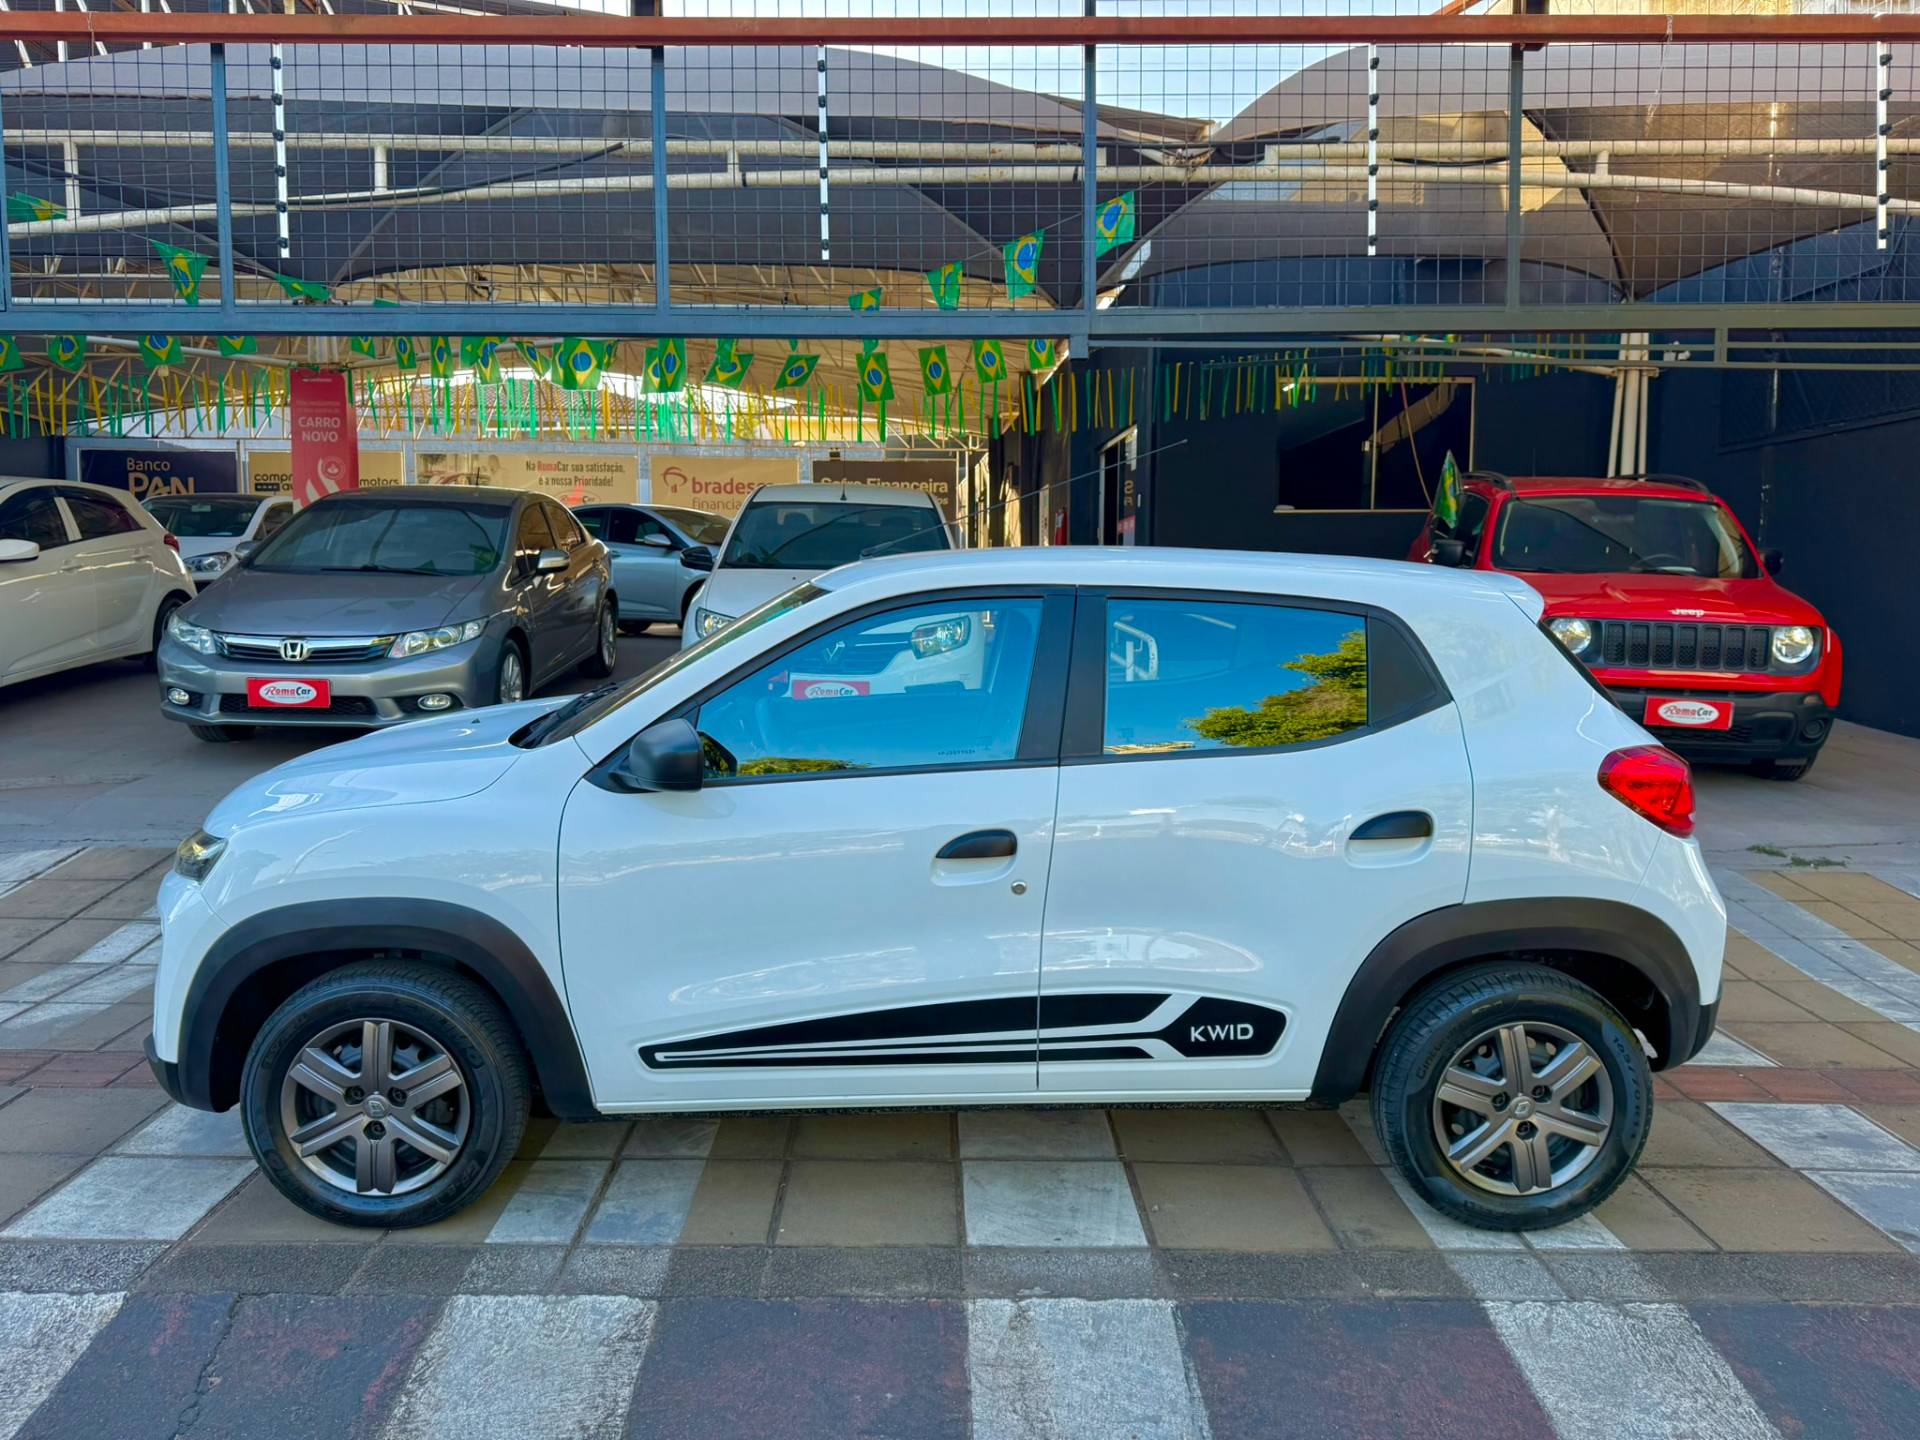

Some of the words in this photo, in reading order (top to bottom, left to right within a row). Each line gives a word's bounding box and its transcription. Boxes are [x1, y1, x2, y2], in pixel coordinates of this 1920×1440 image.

[298, 416, 341, 428] CARRO
[301, 431, 339, 442] NOVO
[127, 458, 170, 471] Banco
[526, 461, 536, 471] Na
[571, 464, 584, 472] sua
[254, 473, 293, 484] compr
[551, 477, 573, 487] nossa
[128, 473, 194, 499] PAN
[691, 476, 775, 495] brades
[264, 686, 312, 696] RomaCar
[1663, 705, 1713, 717] RomaCar
[1190, 1023, 1254, 1042] KWID
